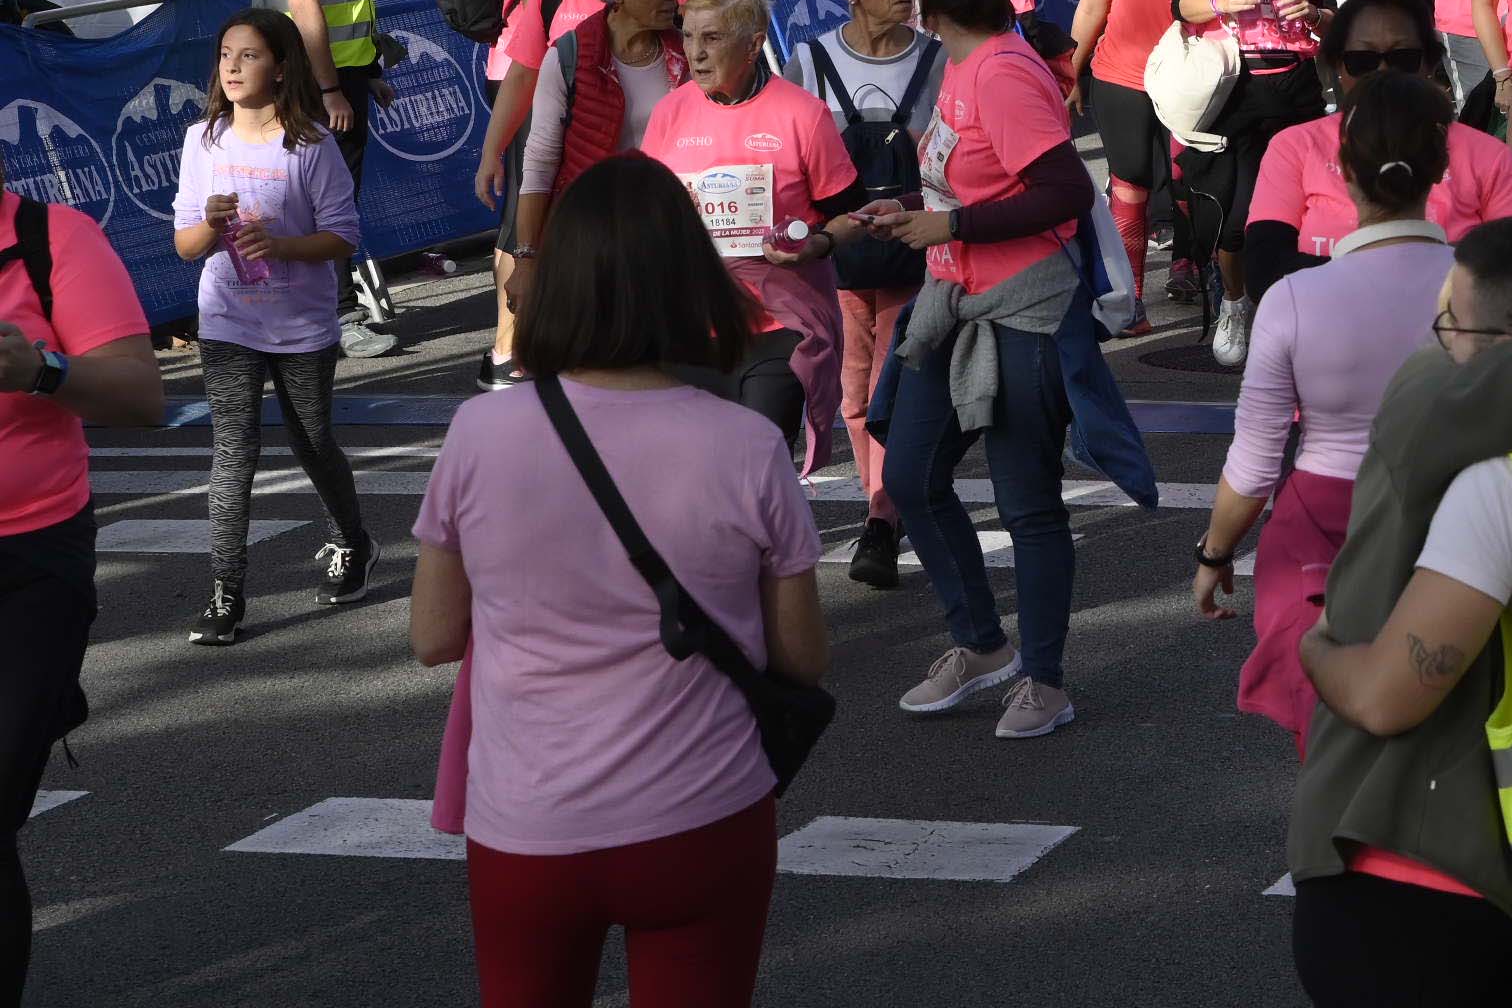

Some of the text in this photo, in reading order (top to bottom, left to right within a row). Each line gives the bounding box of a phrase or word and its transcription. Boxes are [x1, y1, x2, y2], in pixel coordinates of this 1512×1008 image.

[704, 201, 739, 215] 016
[709, 217, 736, 227] 18184
[730, 228, 751, 236] MUJER
